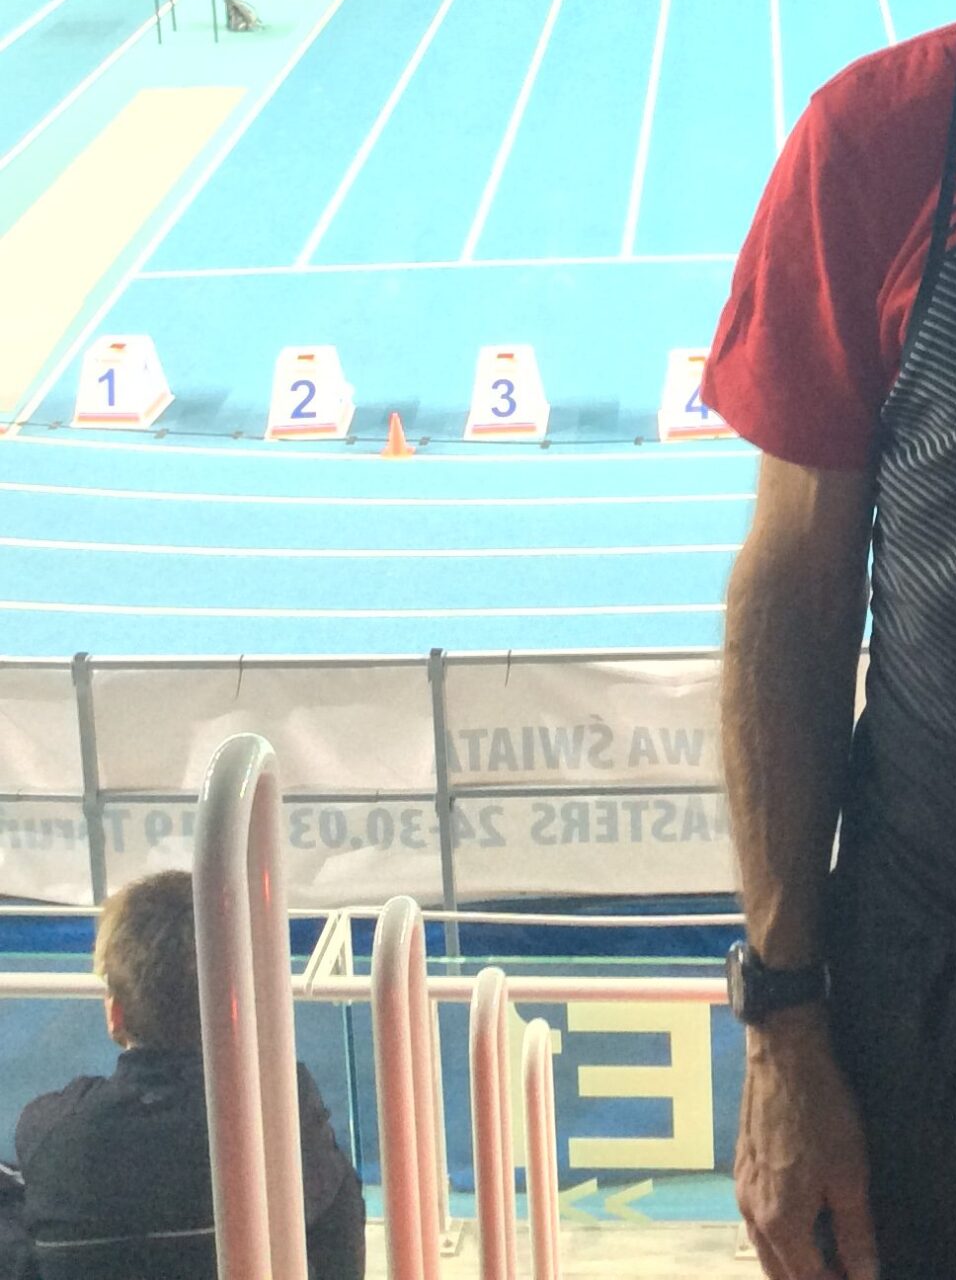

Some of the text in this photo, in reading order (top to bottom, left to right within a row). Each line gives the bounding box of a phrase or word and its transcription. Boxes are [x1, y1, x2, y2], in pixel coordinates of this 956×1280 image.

[97, 369, 117, 406] 1
[288, 380, 318, 419] 2
[489, 379, 518, 418] 3
[684, 383, 710, 420] 4
